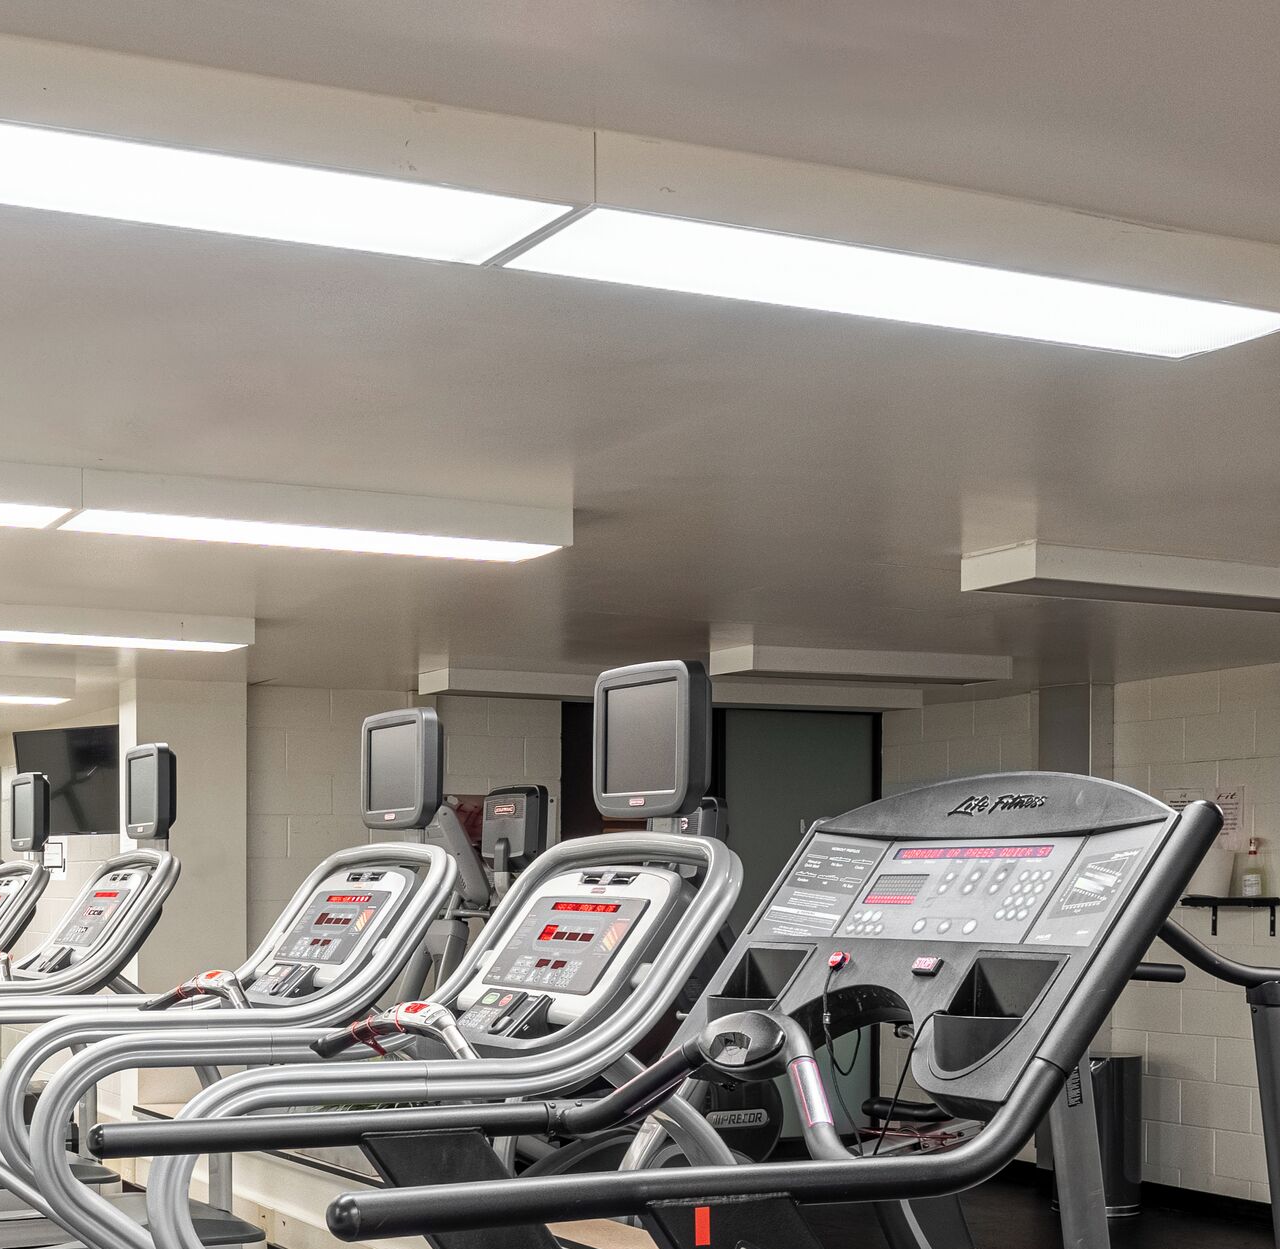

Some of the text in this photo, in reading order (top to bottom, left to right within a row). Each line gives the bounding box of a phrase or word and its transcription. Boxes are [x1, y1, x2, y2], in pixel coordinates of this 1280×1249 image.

[947, 794, 1048, 817] Life Fitness
[902, 849, 944, 859] WORKOUT
[946, 848, 961, 858] OR
[964, 848, 996, 858] PRESS
[1000, 847, 1032, 858] QUICK
[721, 1112, 763, 1125] PRECOR
